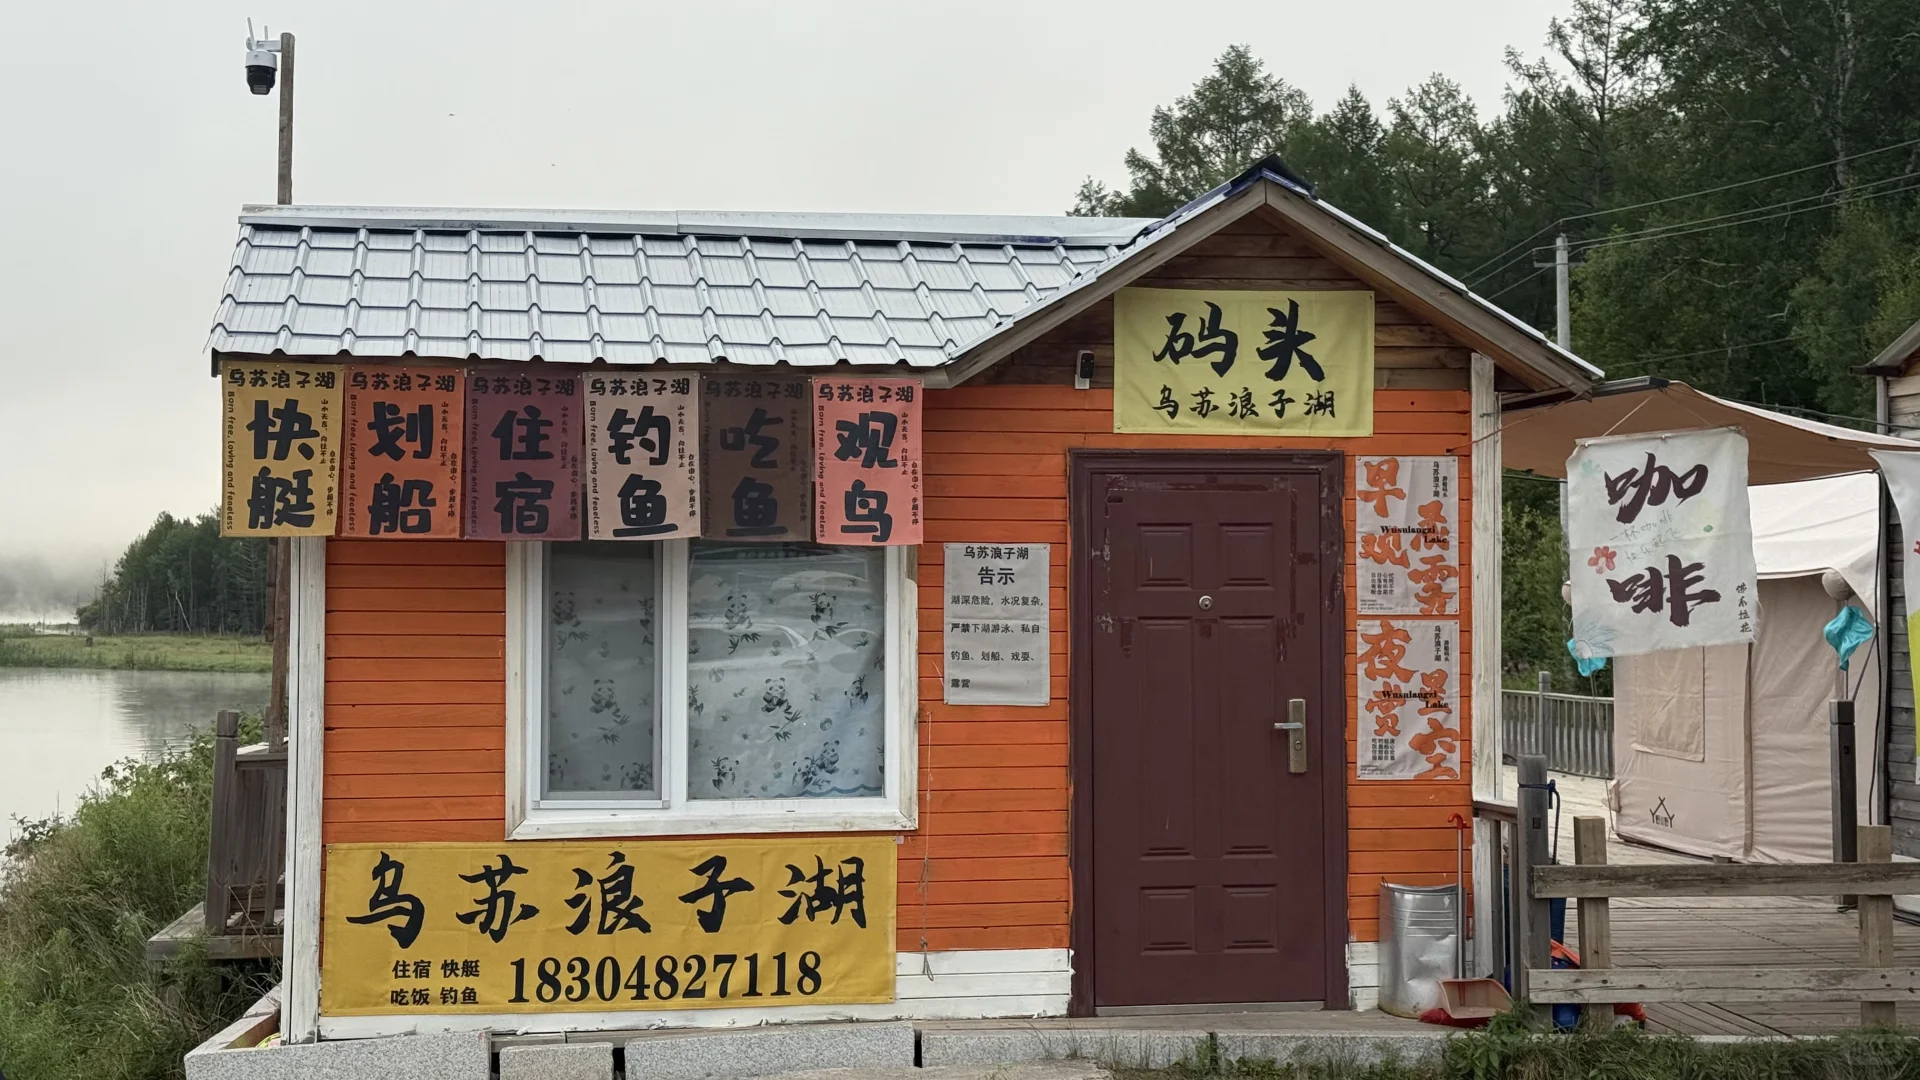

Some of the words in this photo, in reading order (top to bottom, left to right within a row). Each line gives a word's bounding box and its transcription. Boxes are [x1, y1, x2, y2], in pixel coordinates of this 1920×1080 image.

[1152, 297, 1325, 382] 码头
[228, 369, 335, 389] 乌苏浪子湖
[351, 372, 456, 392] 乌苏浪子湖
[472, 376, 574, 396] 乌苏浪子湖
[590, 378, 690, 396] 乌苏浪子湖
[704, 381, 803, 398] 乌苏浪子湖
[819, 384, 914, 403] 乌苏浪子湖
[1153, 384, 1335, 420] 乌苏浪子湖
[226, 441, 235, 468] loving
[246, 399, 320, 529] 快艇
[348, 443, 358, 470] loving
[470, 446, 479, 474] loving
[590, 448, 599, 475] loving
[818, 452, 826, 479] loving
[227, 471, 235, 488] and
[368, 401, 436, 536] 划船
[491, 404, 554, 535] 住宿
[606, 406, 679, 538] 钓鱼
[720, 408, 788, 536] 吃鱼
[833, 410, 898, 543] 观鸟
[1380, 526, 1436, 535] Wusulangzi
[1424, 535, 1448, 544] Lake
[1604, 452, 1721, 627] 咖啡
[964, 546, 1029, 560] 乌苏浪子湖
[978, 566, 1015, 585] 告示
[951, 679, 970, 688] 露营
[1382, 690, 1437, 700] Wusulangzi
[1425, 700, 1449, 709] Lake
[346, 850, 867, 950] 乌苏浪子湖
[392, 959, 432, 979] 住宿
[440, 959, 480, 978] 快艇
[508, 951, 822, 1004] 18304827118
[390, 987, 430, 1005] 吃饭
[439, 986, 479, 1005] 钓鱼
